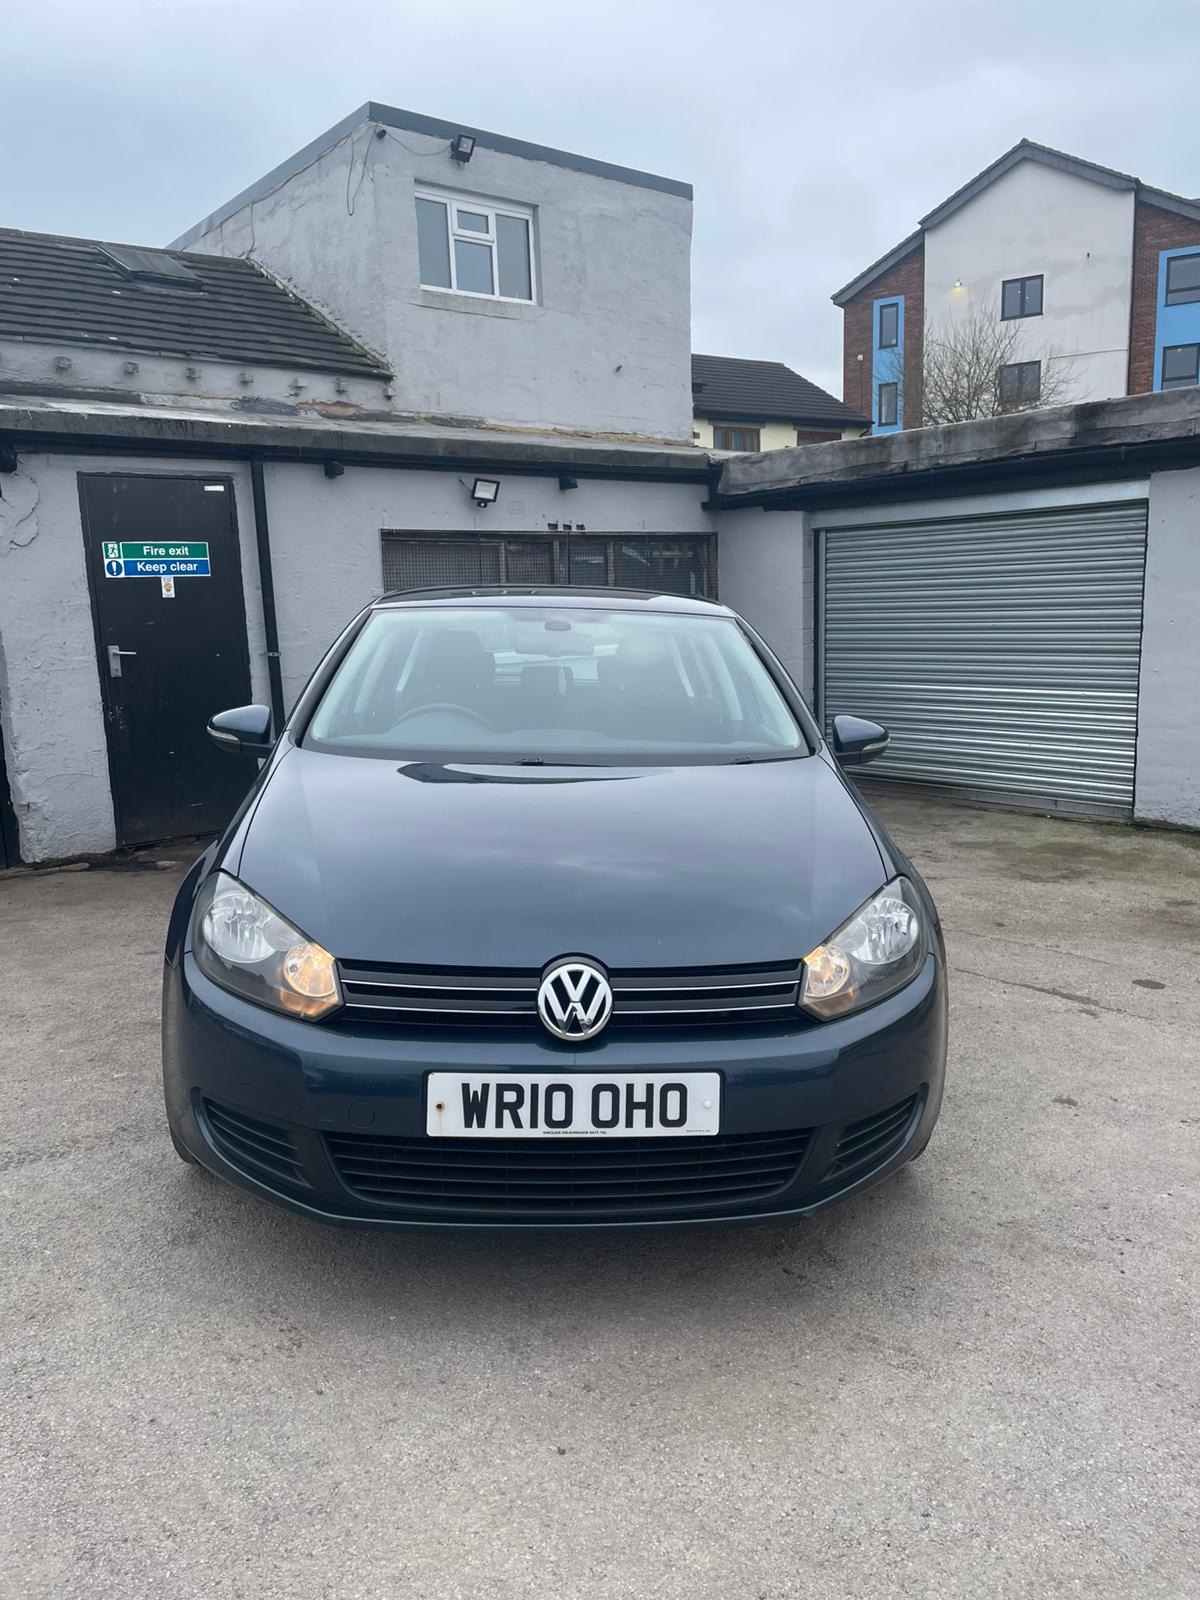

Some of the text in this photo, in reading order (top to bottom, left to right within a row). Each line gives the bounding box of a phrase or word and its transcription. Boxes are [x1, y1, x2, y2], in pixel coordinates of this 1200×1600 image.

[143, 545, 190, 556] Fire exit
[136, 561, 198, 574] Keep clear
[461, 1082, 688, 1129] WR10 OHO
